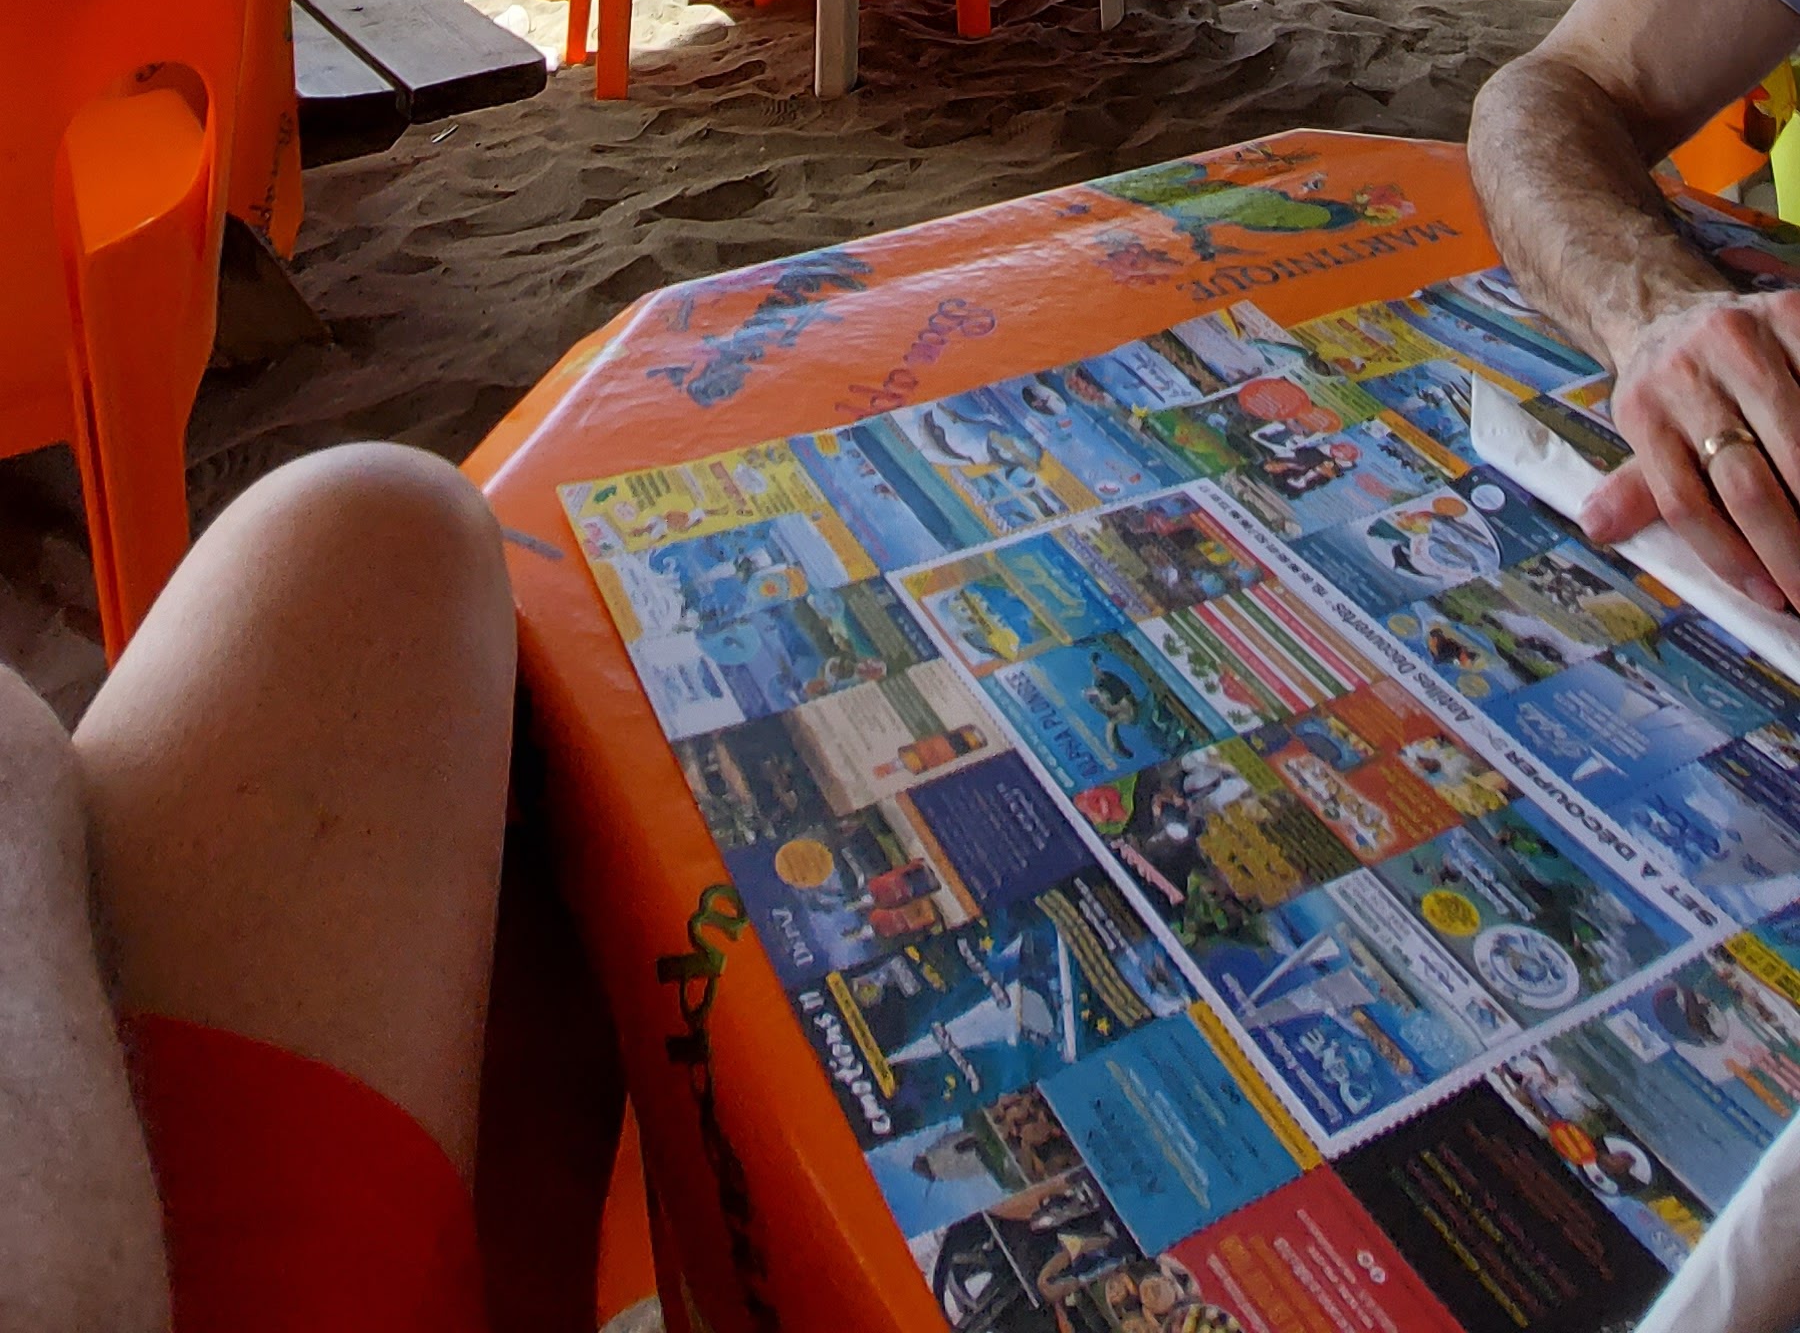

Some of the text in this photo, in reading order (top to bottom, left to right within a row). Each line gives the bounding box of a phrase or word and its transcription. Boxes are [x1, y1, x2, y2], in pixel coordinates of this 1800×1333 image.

[1188, 218, 1463, 303] MARTINIQUE
[1413, 674, 1475, 723] Antilles
[1497, 749, 1640, 863] DÉCOUPER
[1630, 860, 1664, 883] À
[1657, 879, 1721, 929] SET
